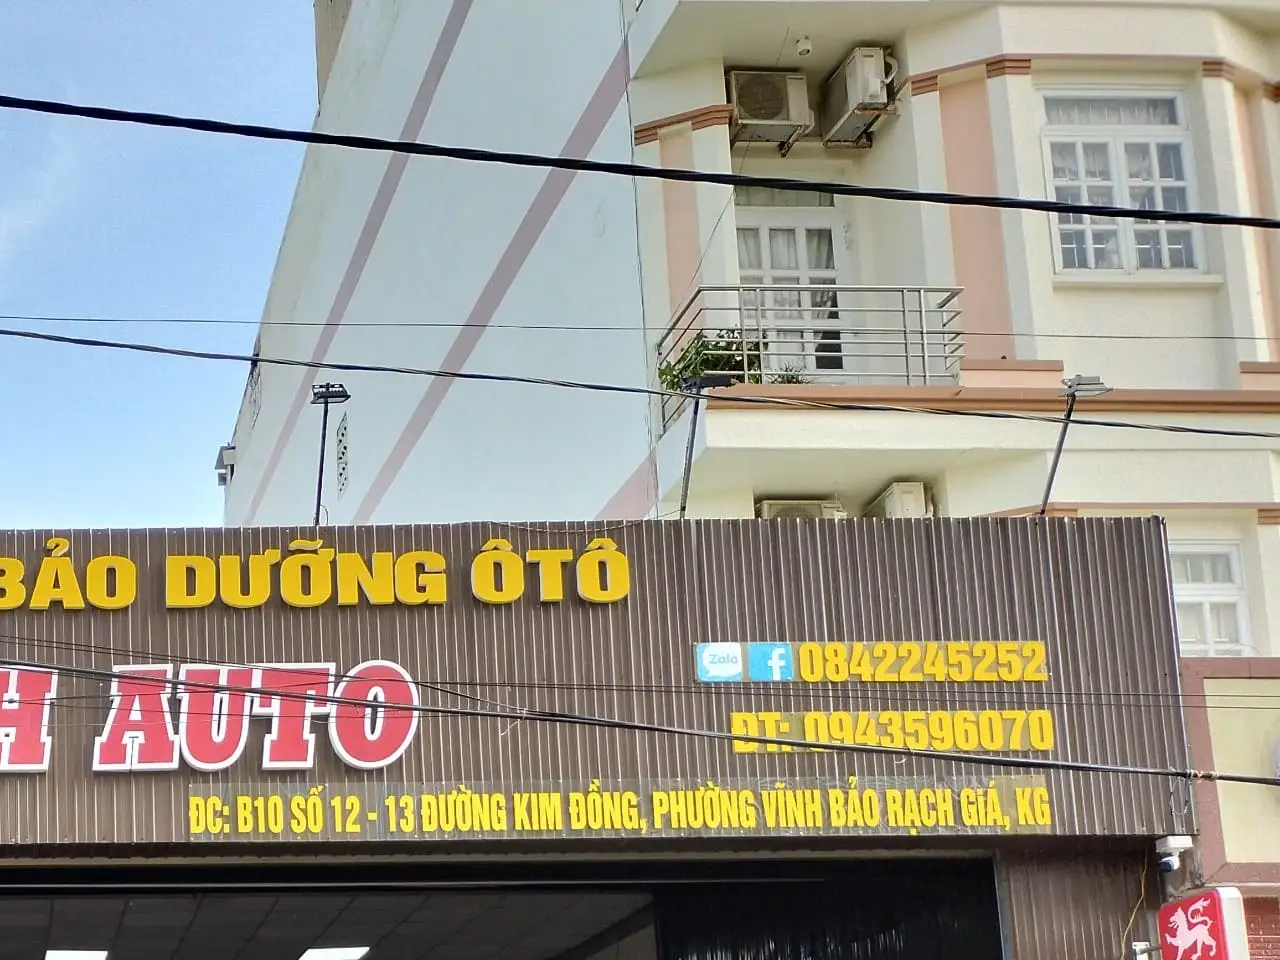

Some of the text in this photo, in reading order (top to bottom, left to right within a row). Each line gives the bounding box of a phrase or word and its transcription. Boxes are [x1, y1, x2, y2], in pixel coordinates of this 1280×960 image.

[166, 539, 447, 610] DƯỠNG
[470, 538, 630, 604] ÔTÔ
[709, 653, 738, 665] Zalo
[798, 641, 1048, 682] 0842245252
[92, 659, 421, 772] AUTO
[803, 710, 1055, 753] 0943596070
[189, 796, 229, 834] ĐC:
[237, 795, 283, 834] B10
[290, 784, 323, 833] SỐ
[331, 795, 360, 833] 12
[385, 795, 414, 832] 13
[421, 784, 507, 832] ĐƯỜNG
[514, 792, 562, 831] KIM
[569, 778, 648, 833] ĐỒNG,
[653, 780, 756, 830] PHƯỜNG
[761, 783, 822, 828] VĨNH
[829, 776, 879, 828] BẢO
[885, 788, 954, 836] RẠCH
[1014, 787, 1051, 826] KG
